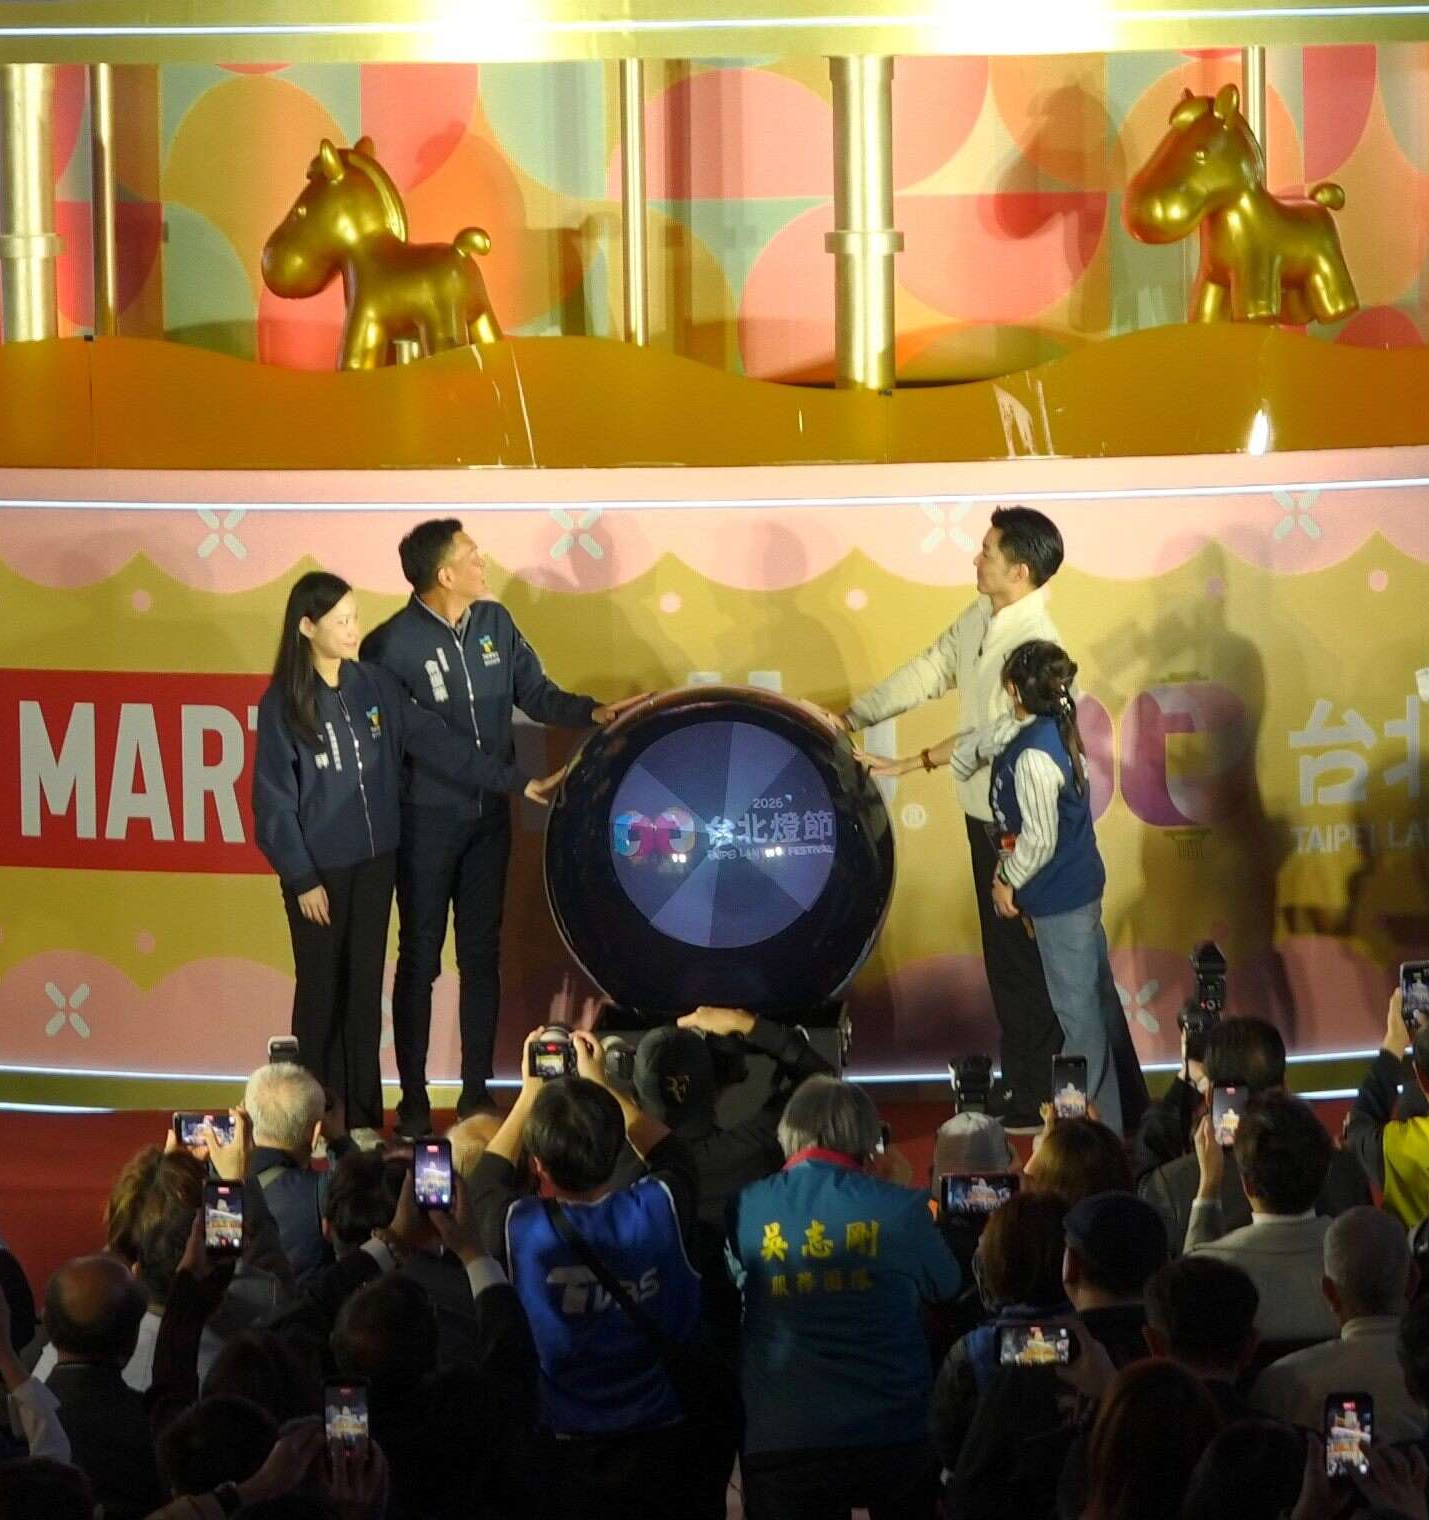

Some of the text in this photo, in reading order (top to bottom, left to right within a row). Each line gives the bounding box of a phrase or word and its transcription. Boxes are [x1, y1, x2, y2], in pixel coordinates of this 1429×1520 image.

[18, 699, 260, 845] MAR
[760, 1220, 874, 1261] 吳志剛
